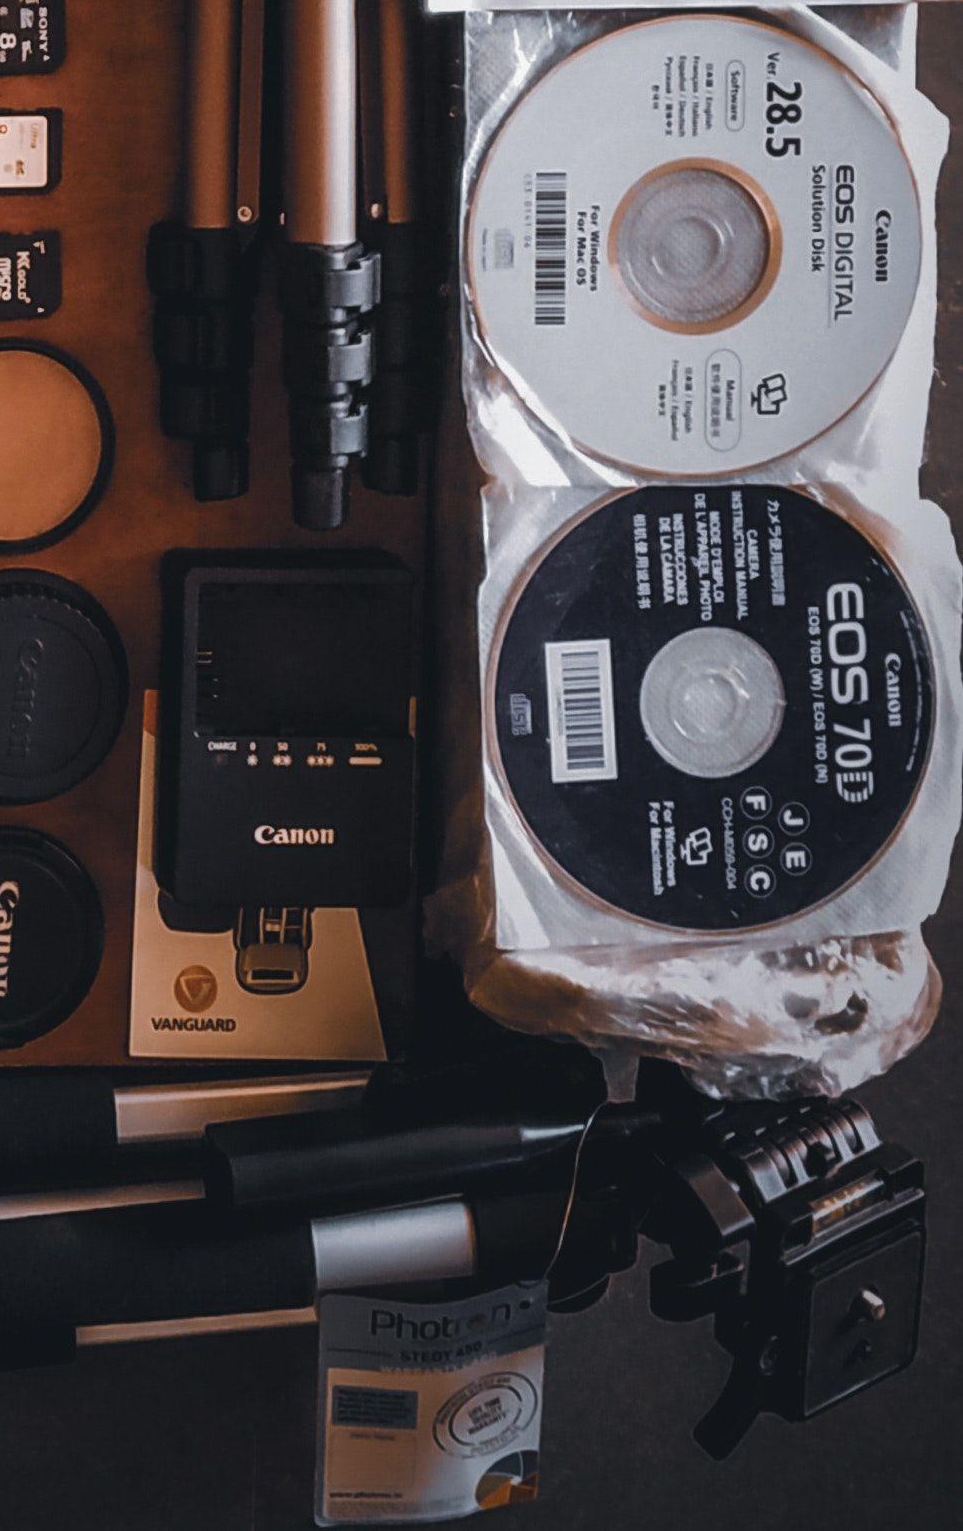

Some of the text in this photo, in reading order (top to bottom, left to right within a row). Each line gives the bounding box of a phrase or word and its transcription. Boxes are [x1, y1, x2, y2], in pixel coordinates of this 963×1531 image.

[0, 33, 17, 50] 8
[39, 7, 48, 52] SONY
[678, 101, 687, 137] Deutsch
[704, 97, 713, 129] English
[729, 70, 740, 121] Software
[766, 52, 802, 157] Ver. 28.5
[576, 211, 587, 286] For Mac OS
[589, 205, 600, 292] For Windows
[811, 165, 825, 272] Solution Disk
[834, 165, 854, 321] EOS DIGITAL
[875, 210, 891, 282] Canon
[726, 380, 736, 421] Manual
[659, 517, 671, 532] DE
[660, 535, 672, 551] LA
[673, 513, 688, 605] INSTRUCCIONES
[695, 493, 712, 621] DE L'APPAREIL PHOTO
[710, 511, 724, 602] MODE D'EMPLOI
[732, 491, 748, 620] INSTRUCTION MANUAL
[747, 529, 760, 580] CAMERA
[7, 639, 44, 758] Canon
[807, 606, 828, 784] EOS 70D (W) EOS 70D (N)
[827, 583, 874, 802] EOS 70D
[884, 653, 902, 727] Canon
[208, 741, 237, 751] CHARGE
[249, 741, 256, 751] 0
[277, 741, 288, 751] 50
[317, 742, 326, 751] 75
[254, 825, 334, 844] Canon
[648, 802, 664, 895] For Macintosh
[663, 801, 677, 887] For Windows
[746, 795, 771, 891] F S C
[783, 810, 806, 869] J E
[151, 1018, 237, 1033] VANGUARD
